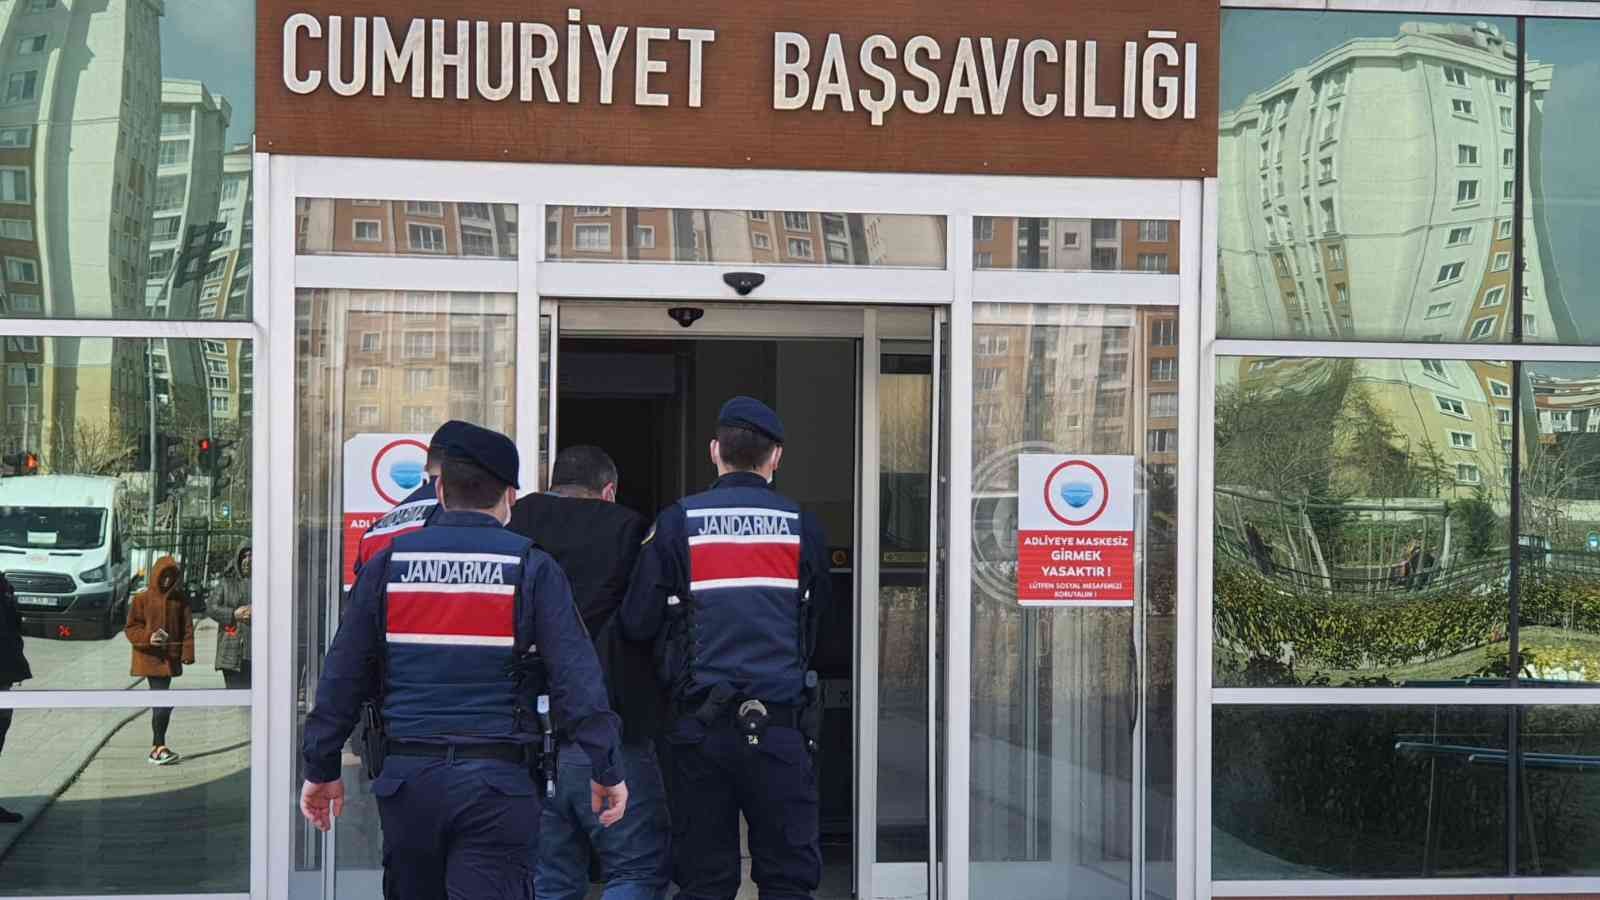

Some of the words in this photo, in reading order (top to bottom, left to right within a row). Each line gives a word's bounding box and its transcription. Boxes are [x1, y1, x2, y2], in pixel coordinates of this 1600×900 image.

[283, 9, 716, 107] CUMHURİYET
[773, 30, 1198, 126] BAŞSAVCILIĞI
[698, 514, 791, 536] JANDARMA
[1023, 534, 1074, 546] ADLİYEYE
[1076, 535, 1129, 546] MASKESİZ
[1050, 547, 1102, 561] GİRMEK
[400, 559, 504, 584] JANDARMA
[1041, 566, 1105, 577] YASAKTIR
